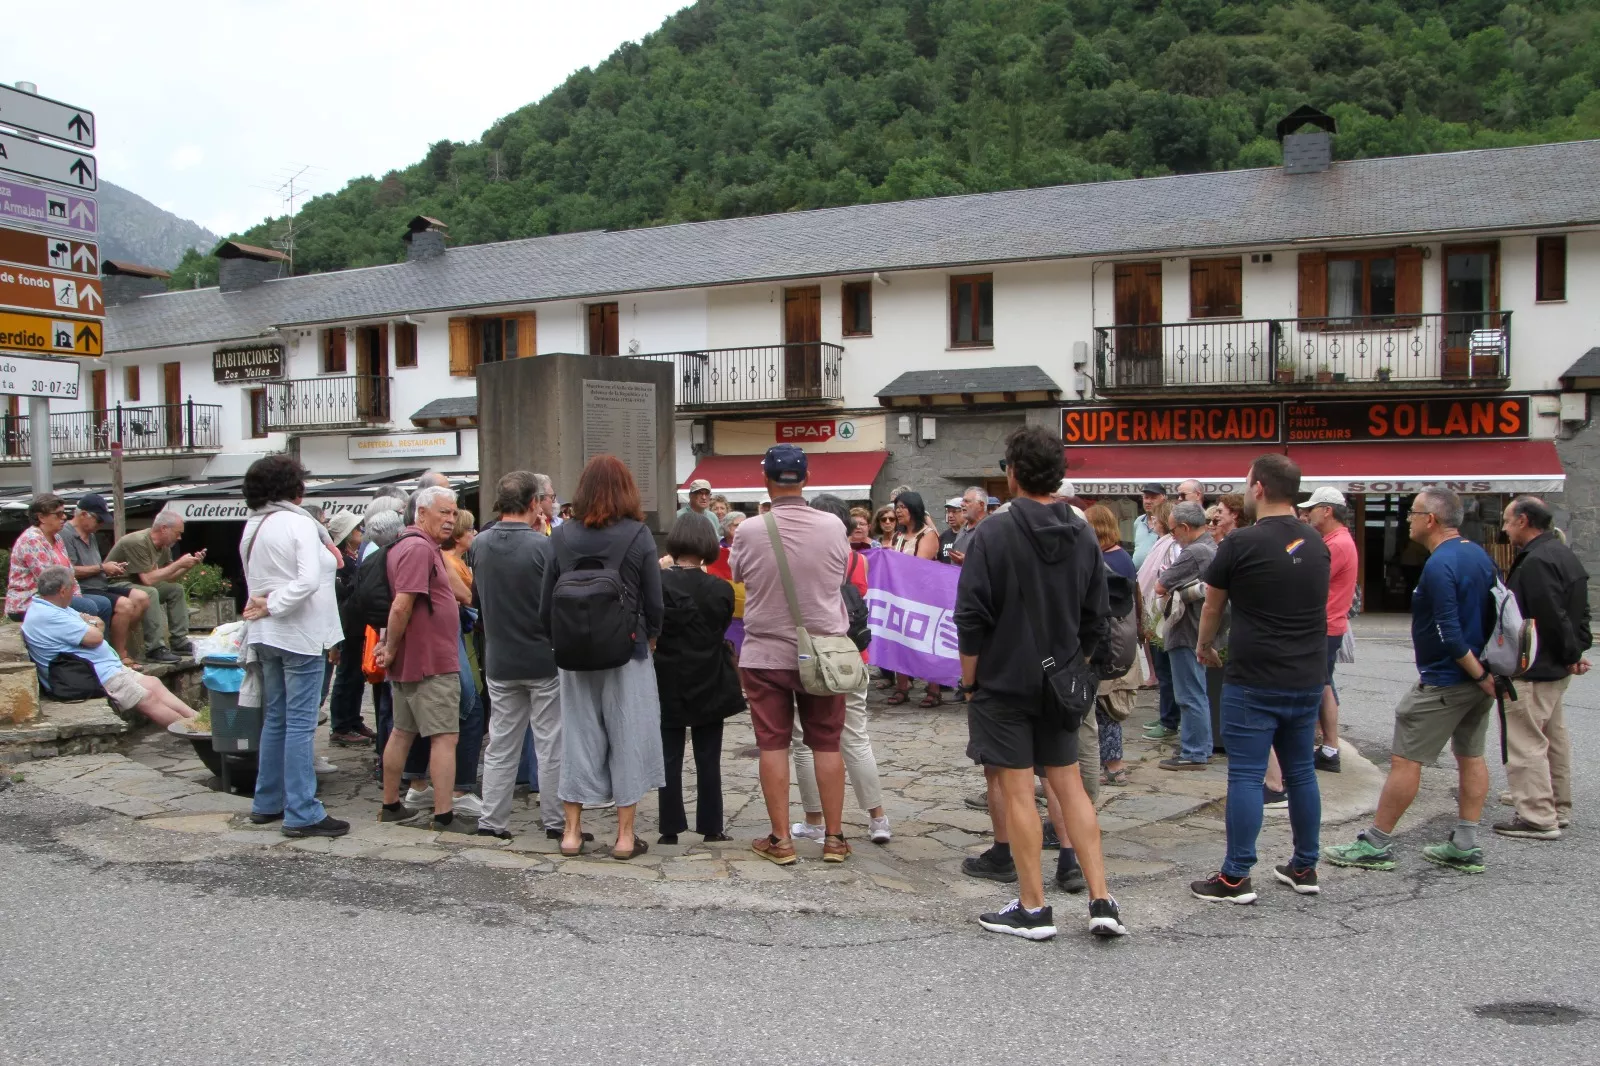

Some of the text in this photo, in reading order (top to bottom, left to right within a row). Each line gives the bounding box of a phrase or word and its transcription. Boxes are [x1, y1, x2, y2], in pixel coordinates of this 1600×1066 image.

[4, 200, 44, 218] Armajani
[0, 272, 51, 289] de fondo
[215, 348, 280, 369] HABITACIONES
[0, 363, 17, 373] do
[225, 369, 239, 379] Los
[1289, 406, 1316, 416] CAVE
[1289, 417, 1329, 428] FRUITS
[1368, 401, 1521, 436] SOLANS
[782, 425, 831, 437] SPAR
[1066, 408, 1275, 442] SUPERMERCADO
[1289, 429, 1352, 440] SOUVENIRS
[399, 438, 447, 448] RESTAURANTE
[864, 599, 930, 642] COO
